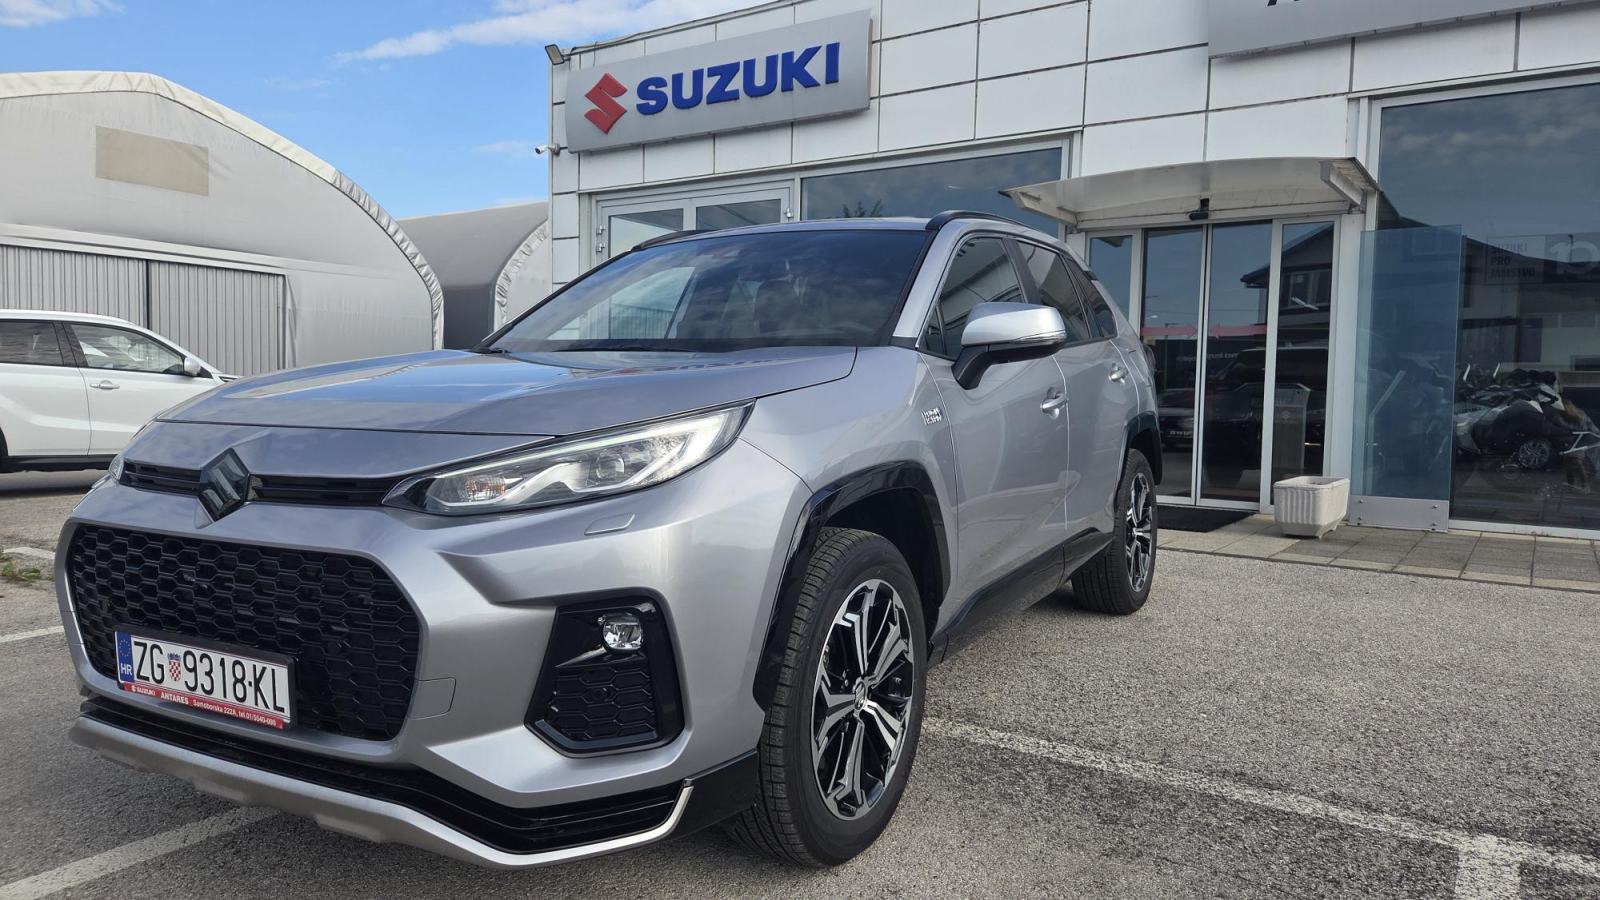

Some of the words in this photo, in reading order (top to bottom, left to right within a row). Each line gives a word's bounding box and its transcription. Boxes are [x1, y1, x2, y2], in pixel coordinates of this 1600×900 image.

[636, 42, 840, 115] SUZUKI
[121, 663, 132, 675] HR
[134, 641, 165, 684] ZG
[137, 687, 156, 696] SUZUKI
[160, 692, 189, 705] ANTARES
[193, 699, 223, 712] Samoborska
